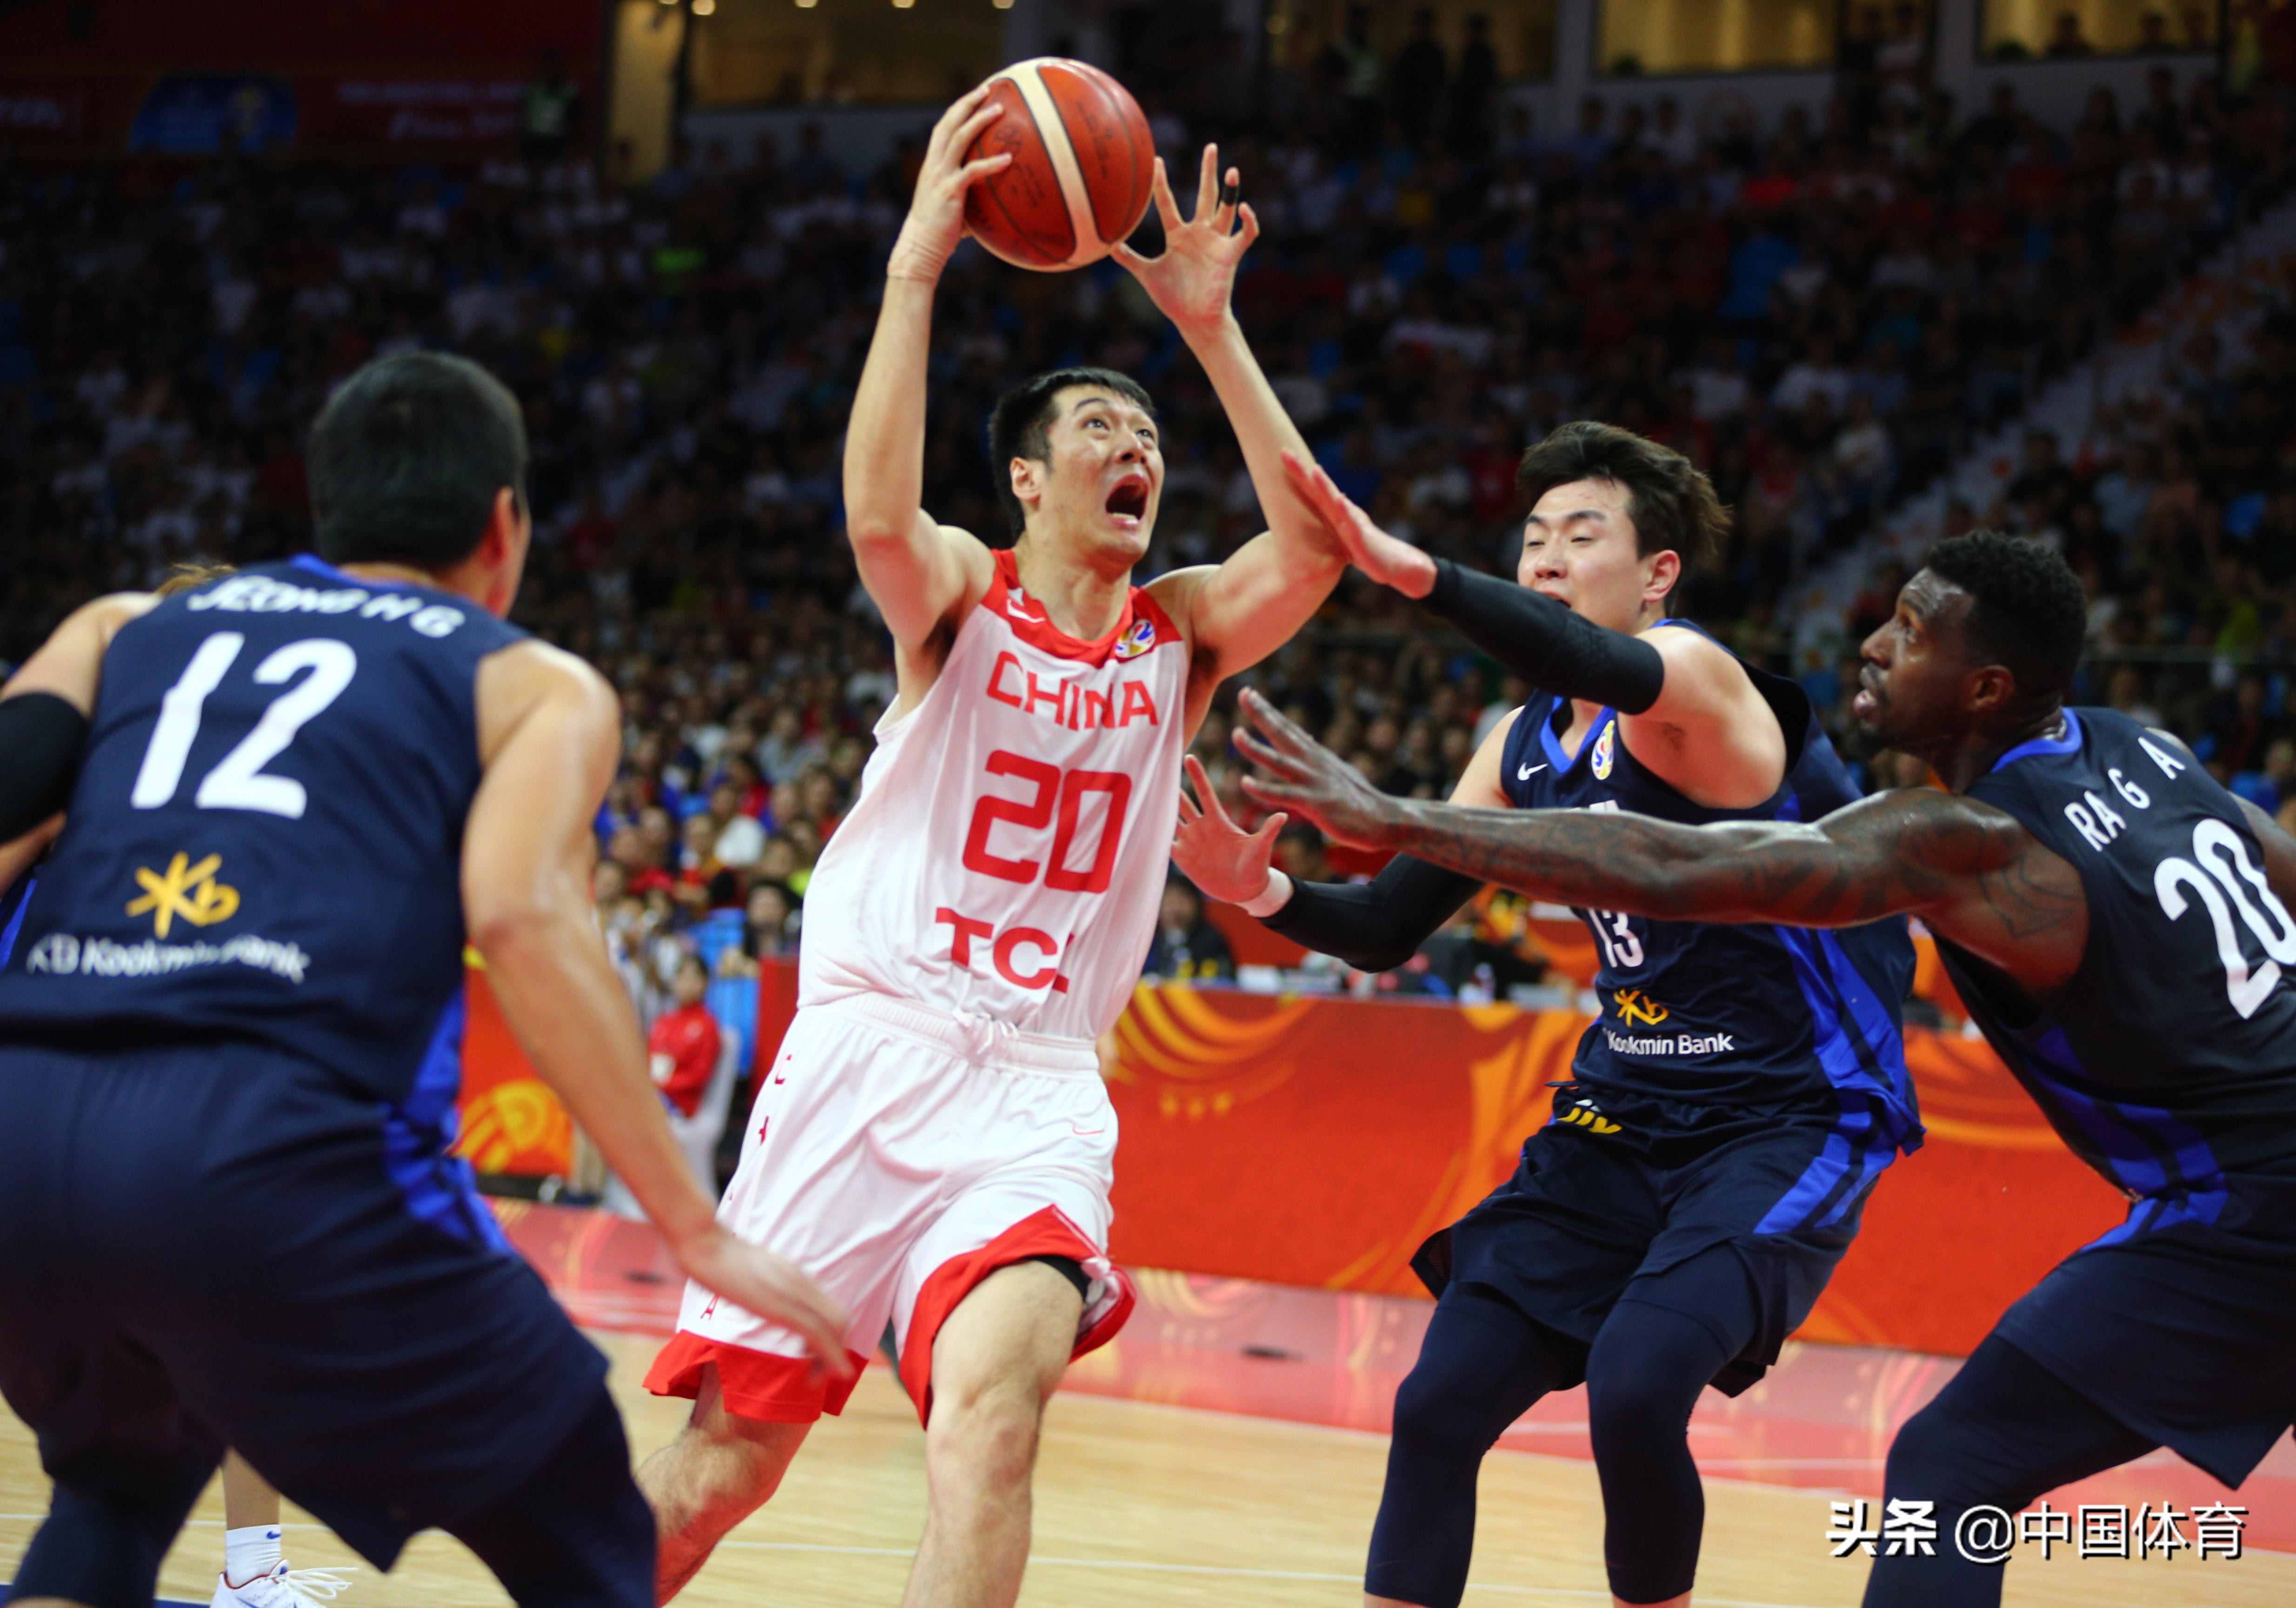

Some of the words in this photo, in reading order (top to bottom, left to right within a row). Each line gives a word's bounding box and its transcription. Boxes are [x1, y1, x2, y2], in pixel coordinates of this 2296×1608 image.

[187, 575, 370, 614] JEONG
[130, 630, 358, 819] 12
[986, 650, 1159, 731] CHINA
[962, 749, 1133, 895] 20
[1588, 908, 1644, 968] 13
[2153, 817, 2296, 1019] 20
[27, 933, 80, 975] KB
[1607, 1030, 1674, 1055] Kookmin
[1677, 1032, 1735, 1055] Bank
